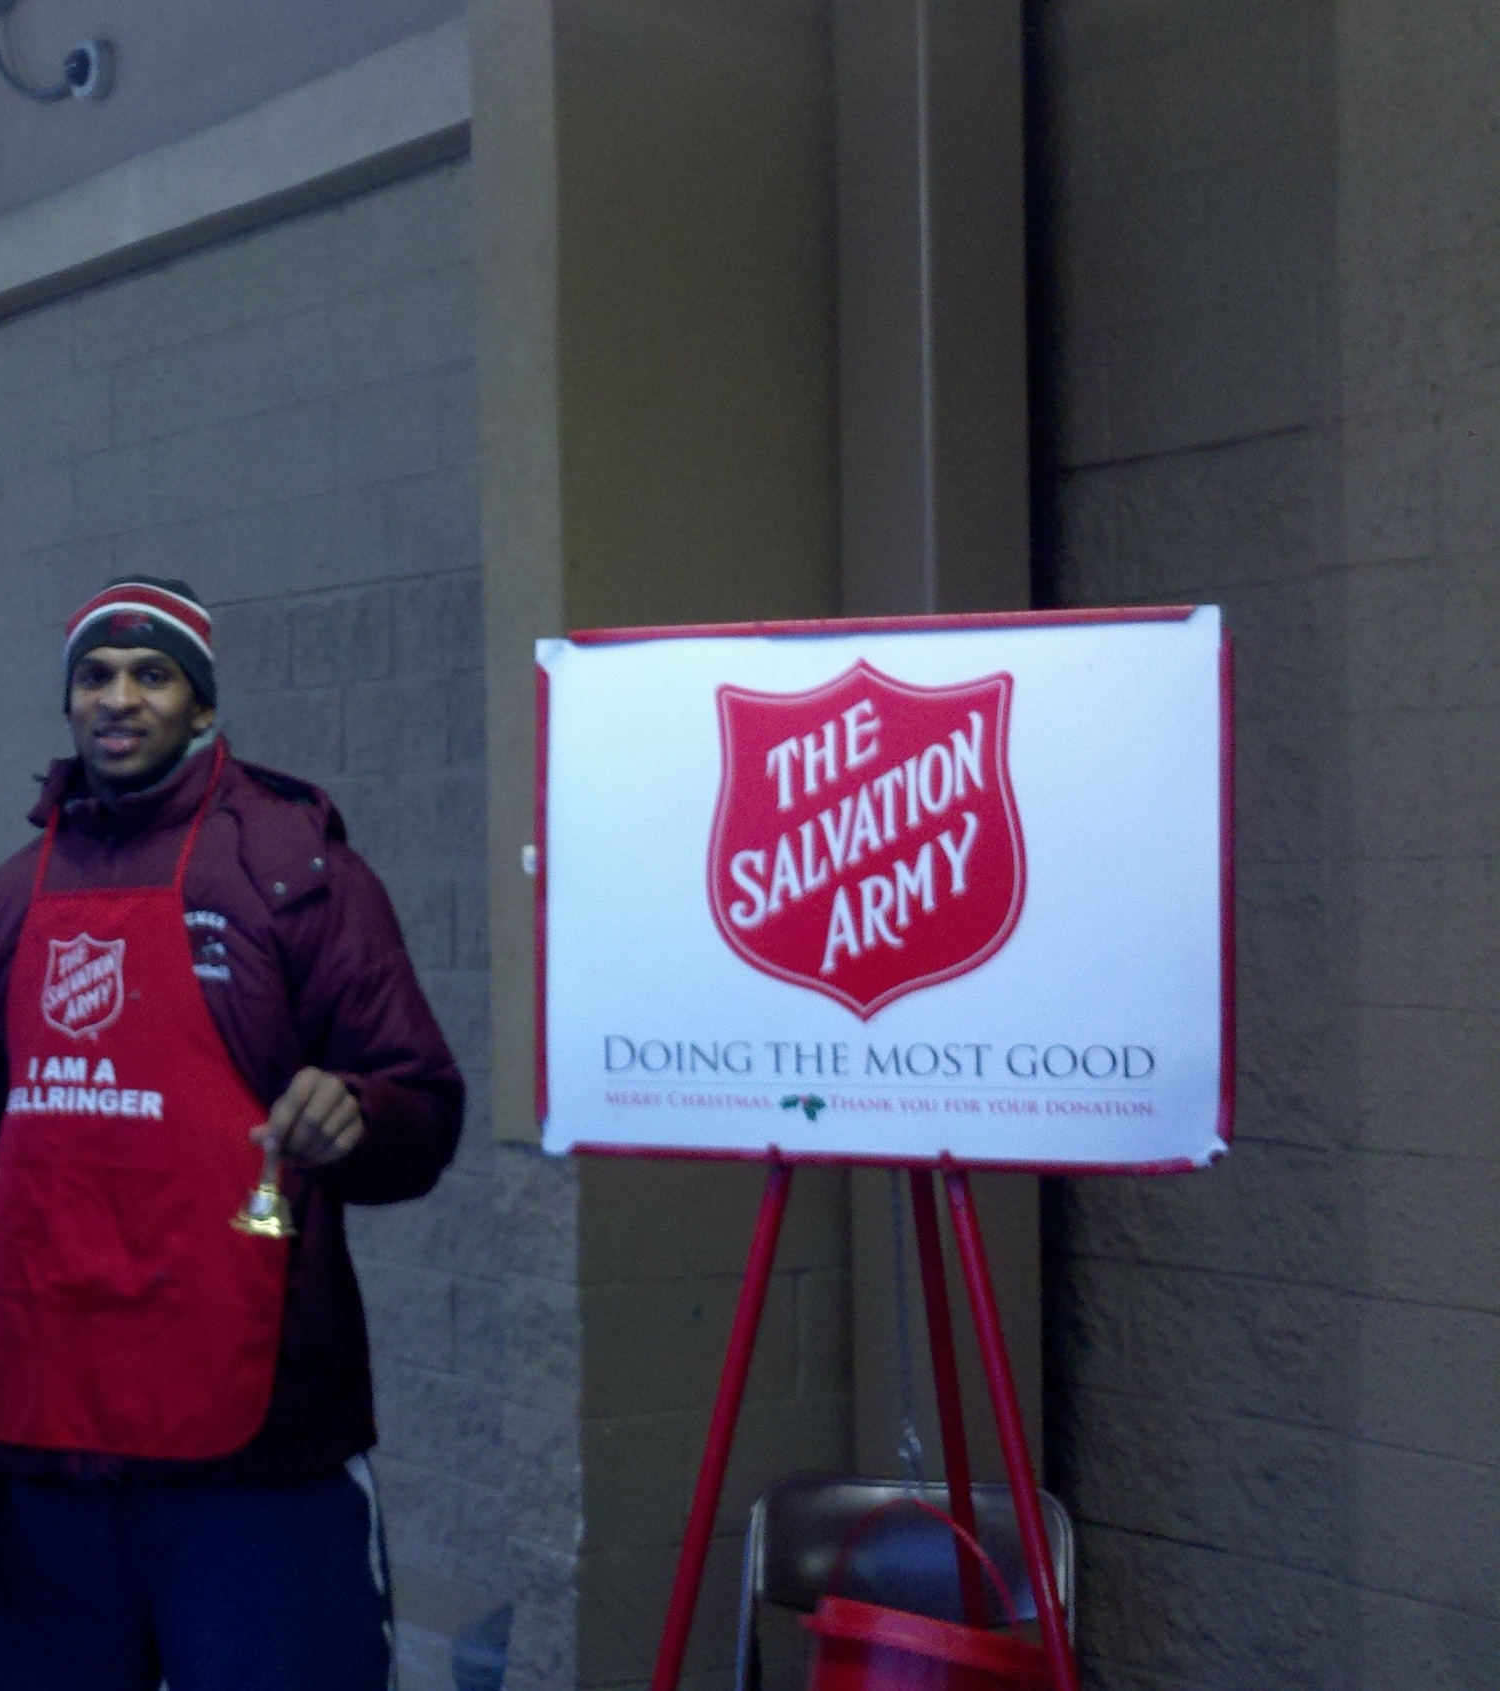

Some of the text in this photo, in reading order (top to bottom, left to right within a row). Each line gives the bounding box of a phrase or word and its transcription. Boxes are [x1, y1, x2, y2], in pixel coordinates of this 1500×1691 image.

[766, 699, 882, 811] THE
[728, 711, 986, 929] SALVATION
[819, 811, 978, 976] ARMY
[28, 1056, 116, 1085] I AM A
[603, 1034, 1156, 1079] DOING THE MOST GOOD
